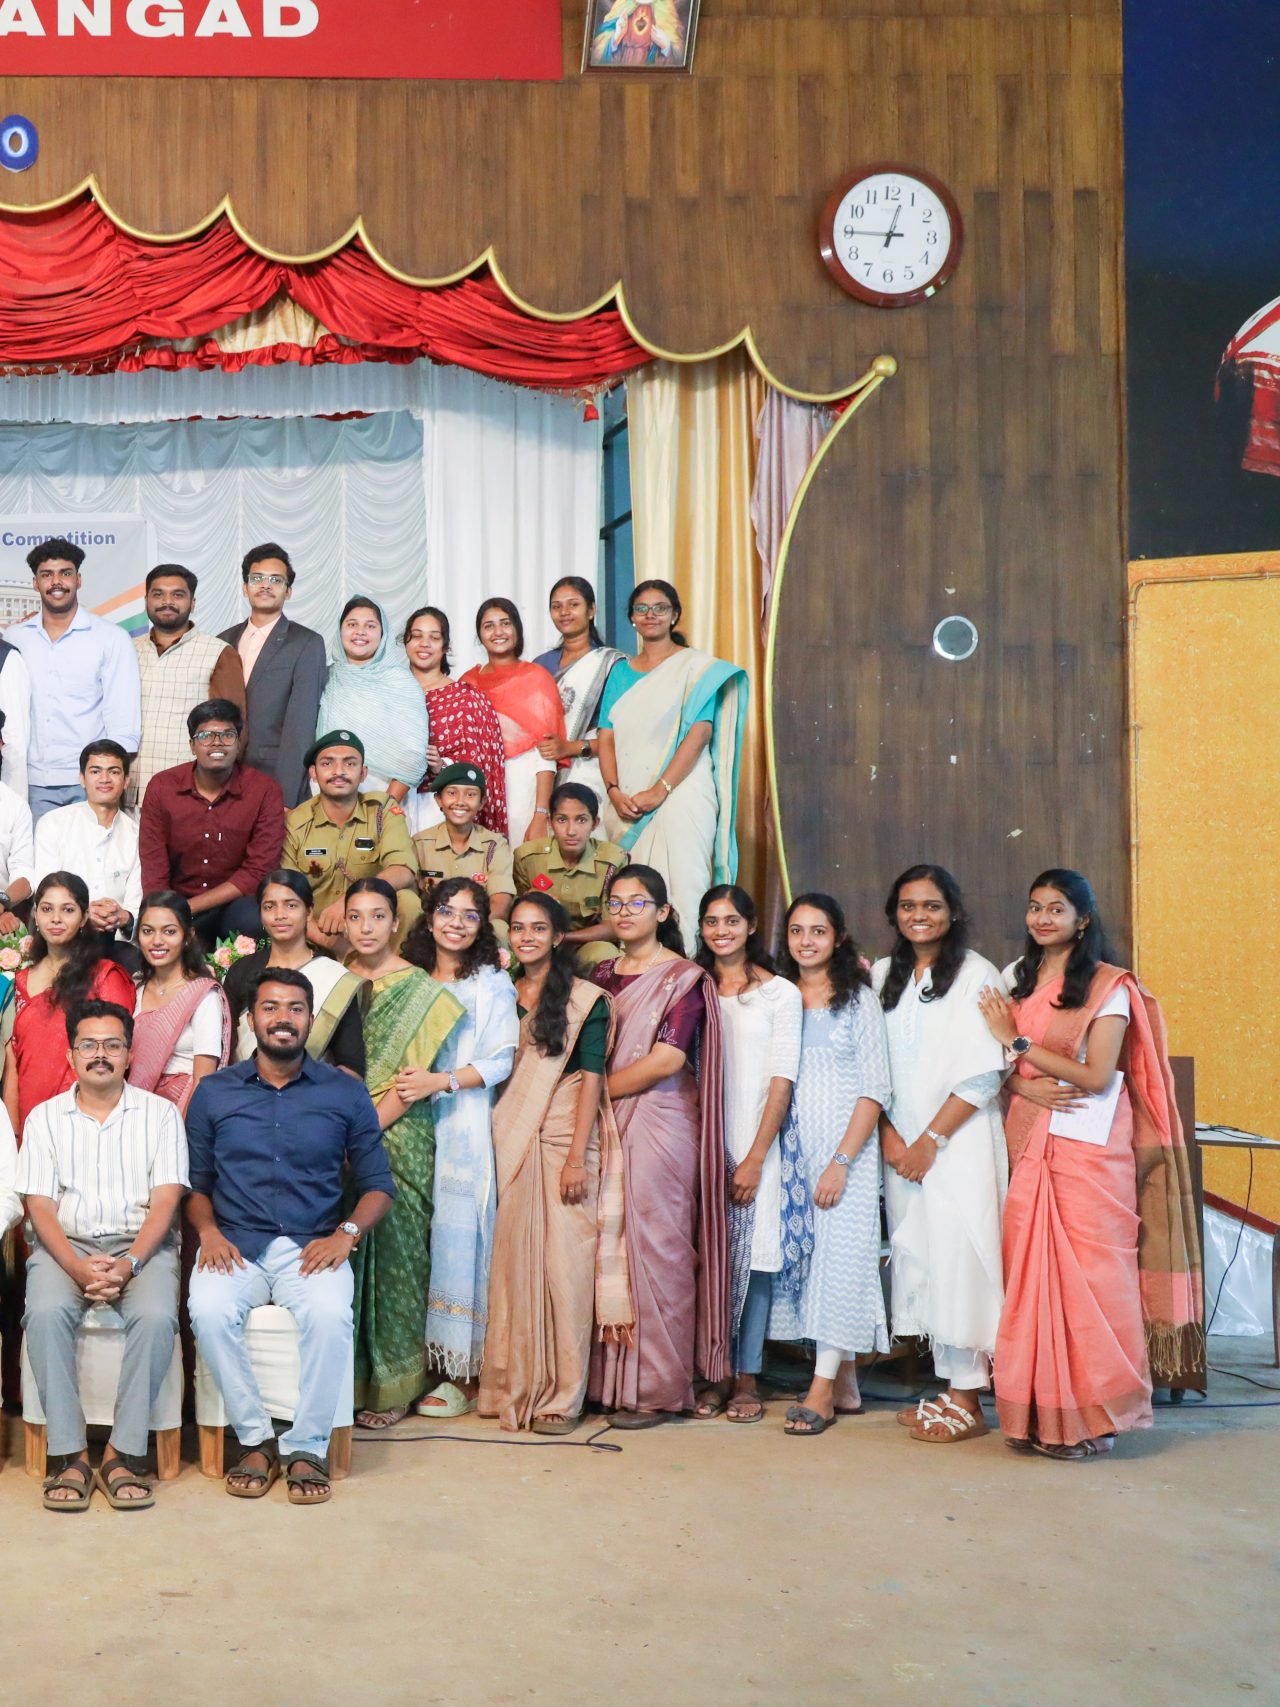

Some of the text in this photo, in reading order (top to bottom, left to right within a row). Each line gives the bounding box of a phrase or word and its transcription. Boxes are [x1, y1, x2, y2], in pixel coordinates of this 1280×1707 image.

[866, 190, 877, 204] 11
[885, 185, 901, 200] 12
[850, 204, 864, 218] 10
[922, 209, 932, 223] 2
[843, 226, 854, 239] 9
[927, 231, 937, 244] 3
[848, 246, 859, 260] 8
[919, 251, 929, 265] 4
[864, 263, 873, 277] 7
[883, 269, 893, 283] 6
[904, 266, 914, 280] 5
